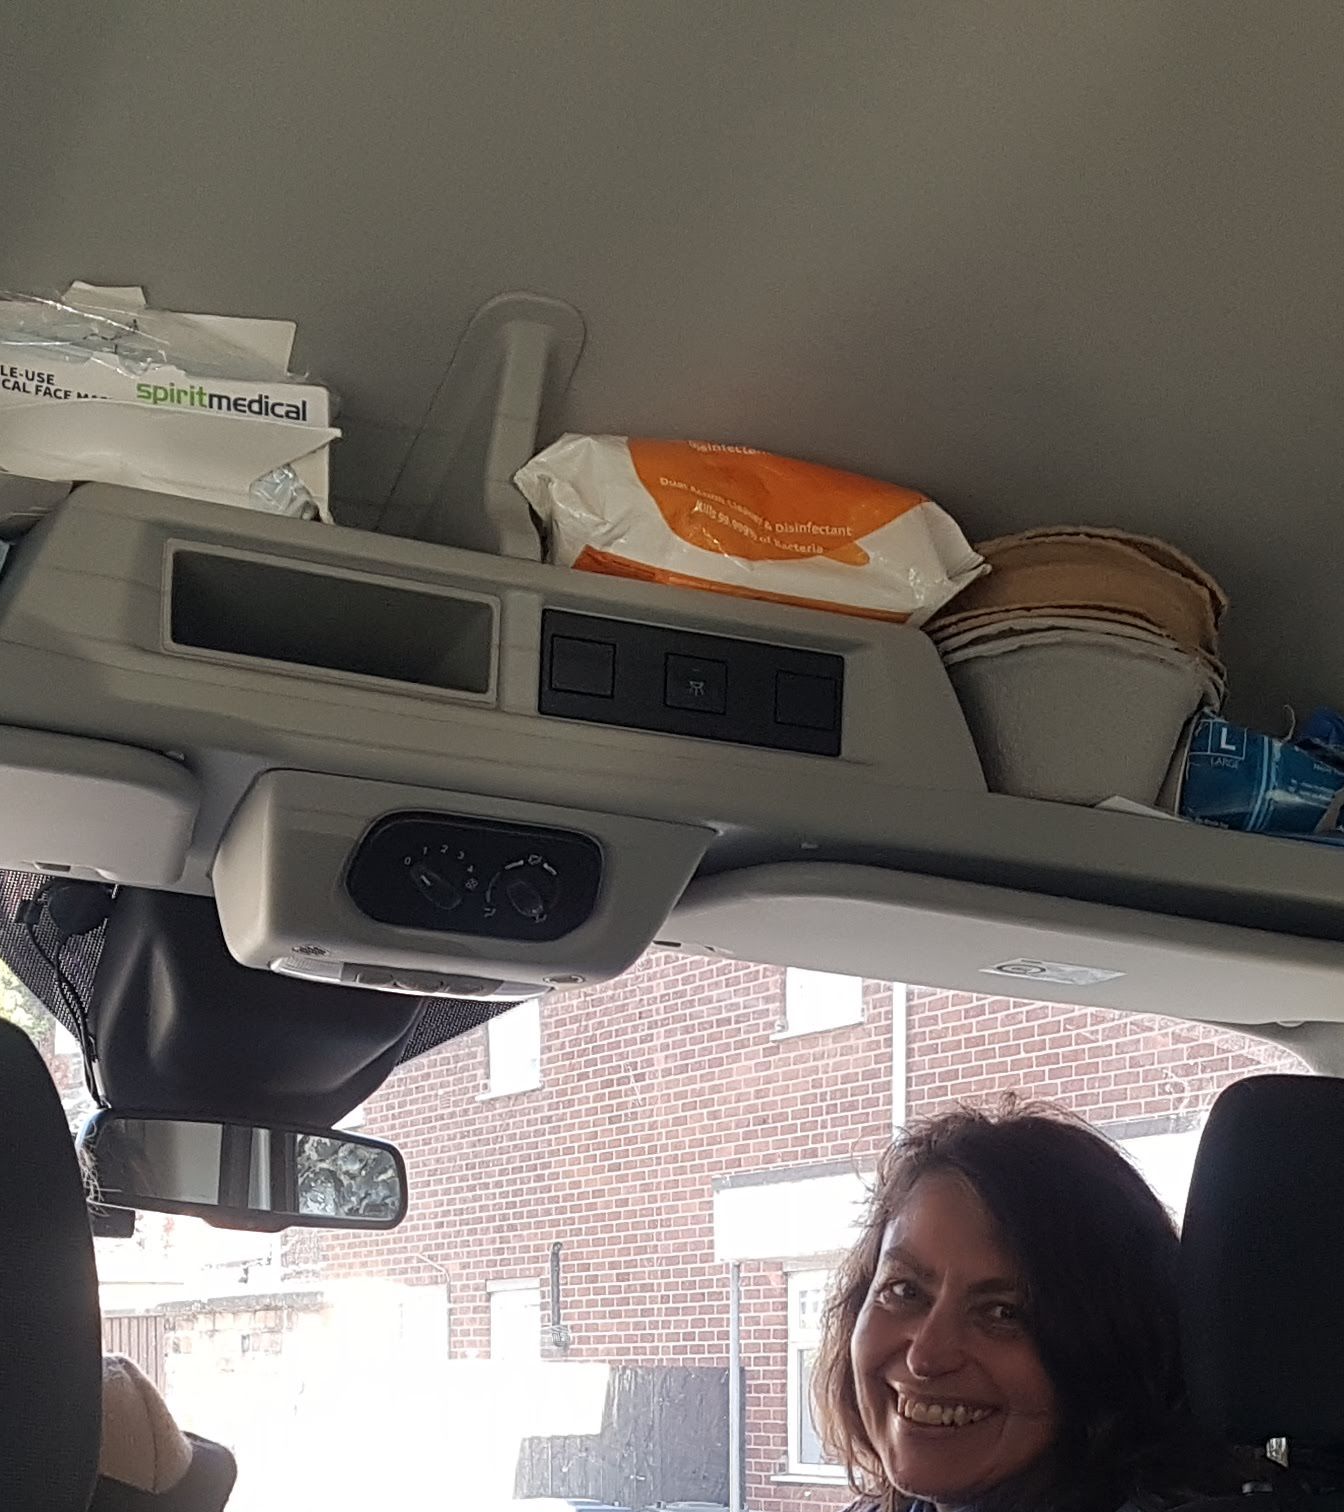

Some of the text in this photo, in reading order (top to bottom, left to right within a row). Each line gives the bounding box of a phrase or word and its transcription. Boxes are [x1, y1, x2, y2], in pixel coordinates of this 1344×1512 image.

[35, 385, 72, 400] FACE
[136, 382, 307, 422] spiritmedical
[776, 521, 854, 537] Disinfectant
[1220, 727, 1236, 751] L
